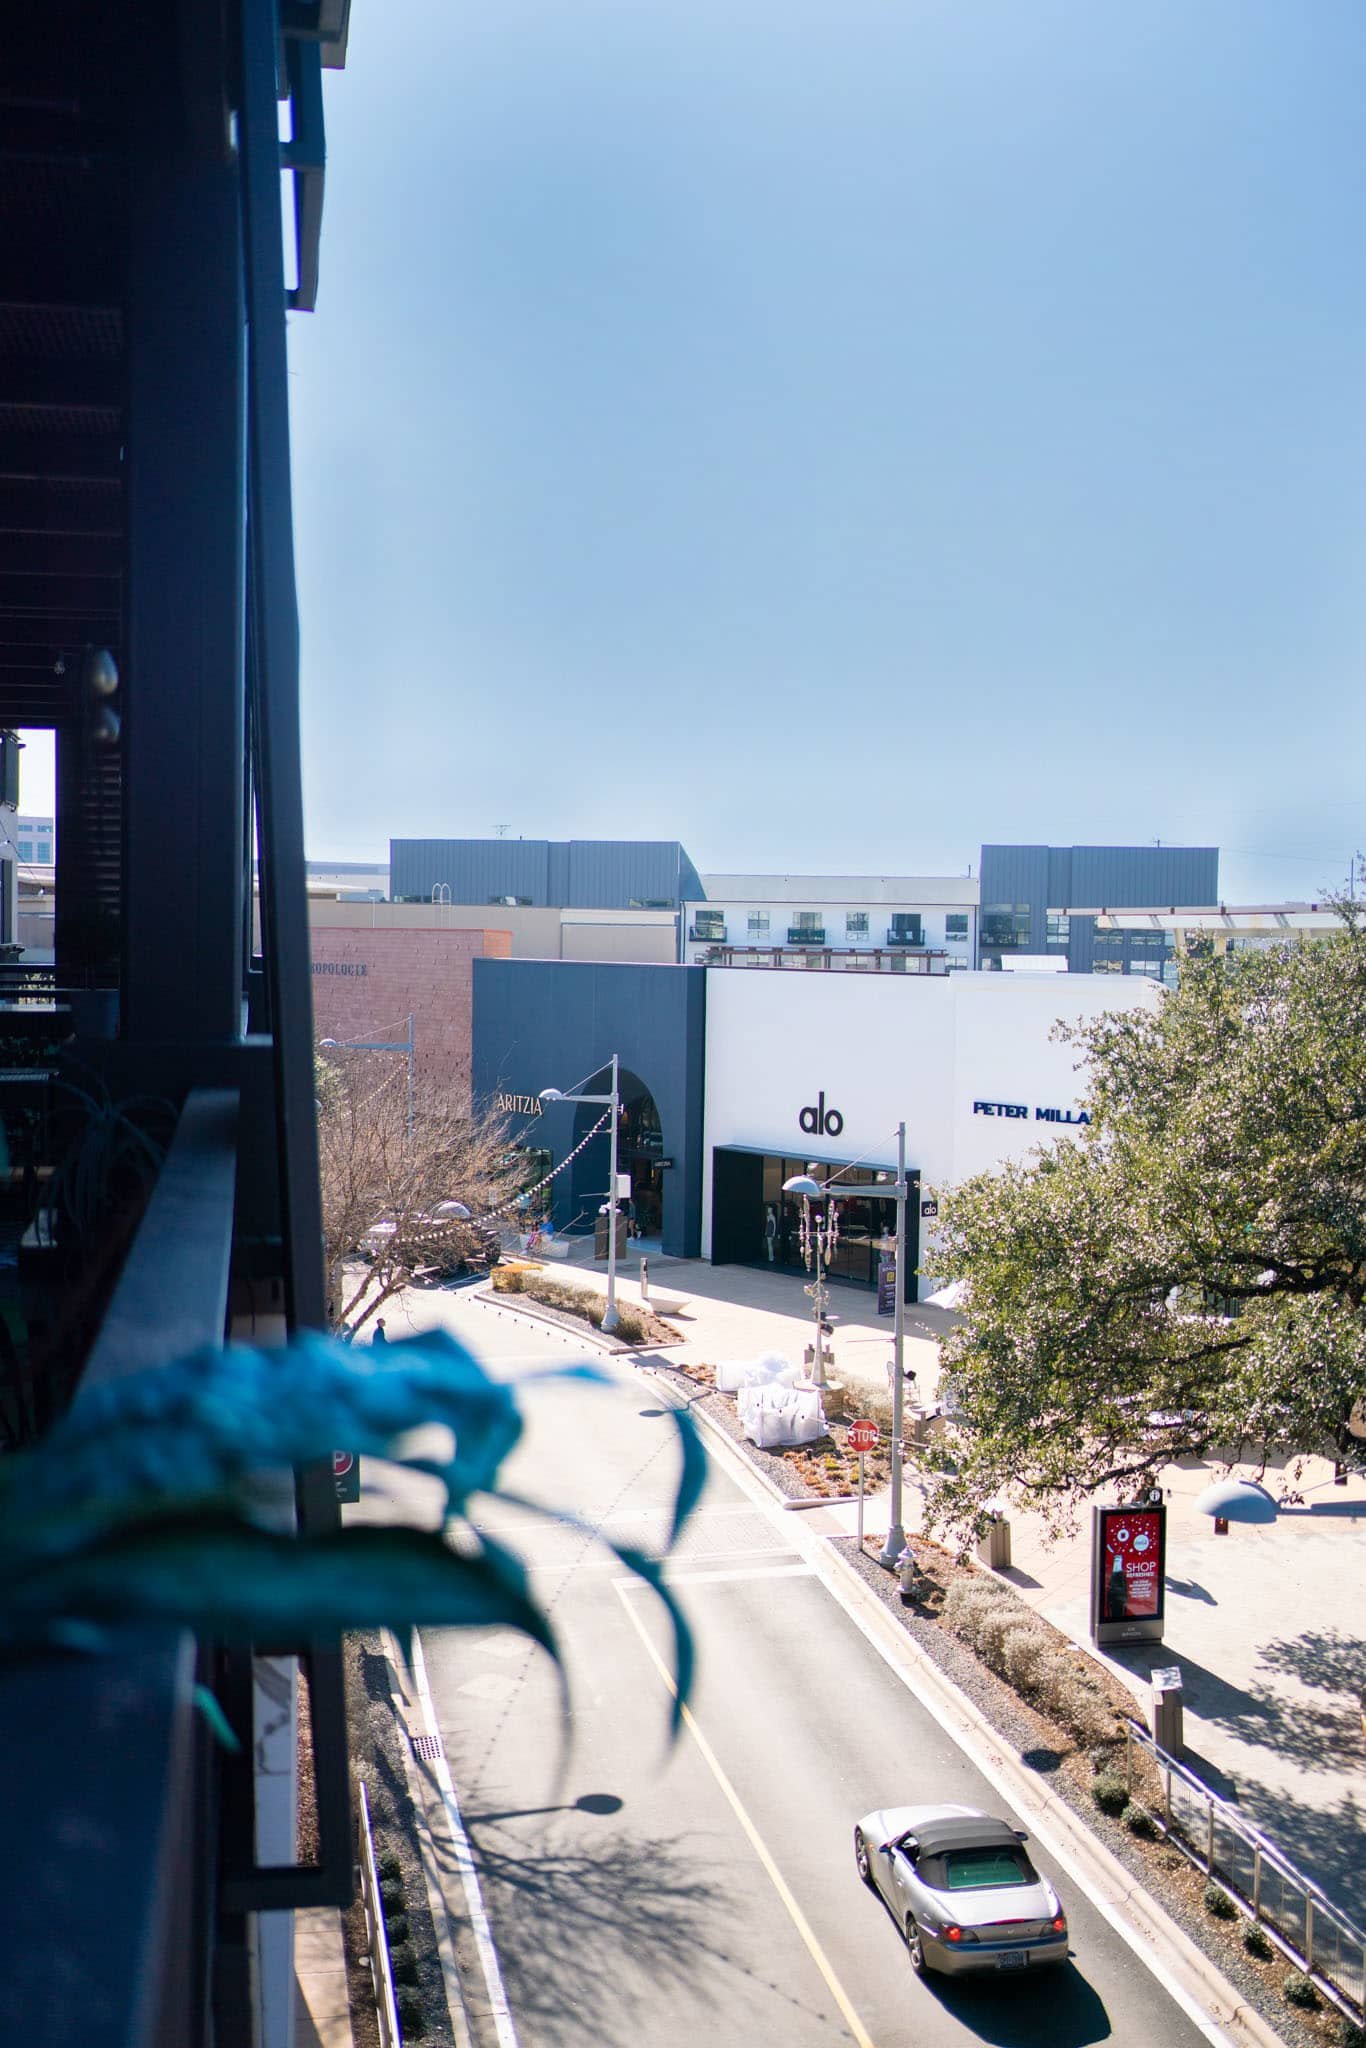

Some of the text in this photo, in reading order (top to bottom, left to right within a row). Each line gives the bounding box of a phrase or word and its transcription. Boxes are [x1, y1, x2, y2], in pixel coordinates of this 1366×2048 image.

[497, 1093, 543, 1116] ARITZIA
[799, 1091, 844, 1136] alo
[974, 1101, 1091, 1125] PETER MILLA
[924, 1203, 937, 1214] alo
[848, 1429, 876, 1442] STOP
[1126, 1561, 1157, 1572] SHOP
